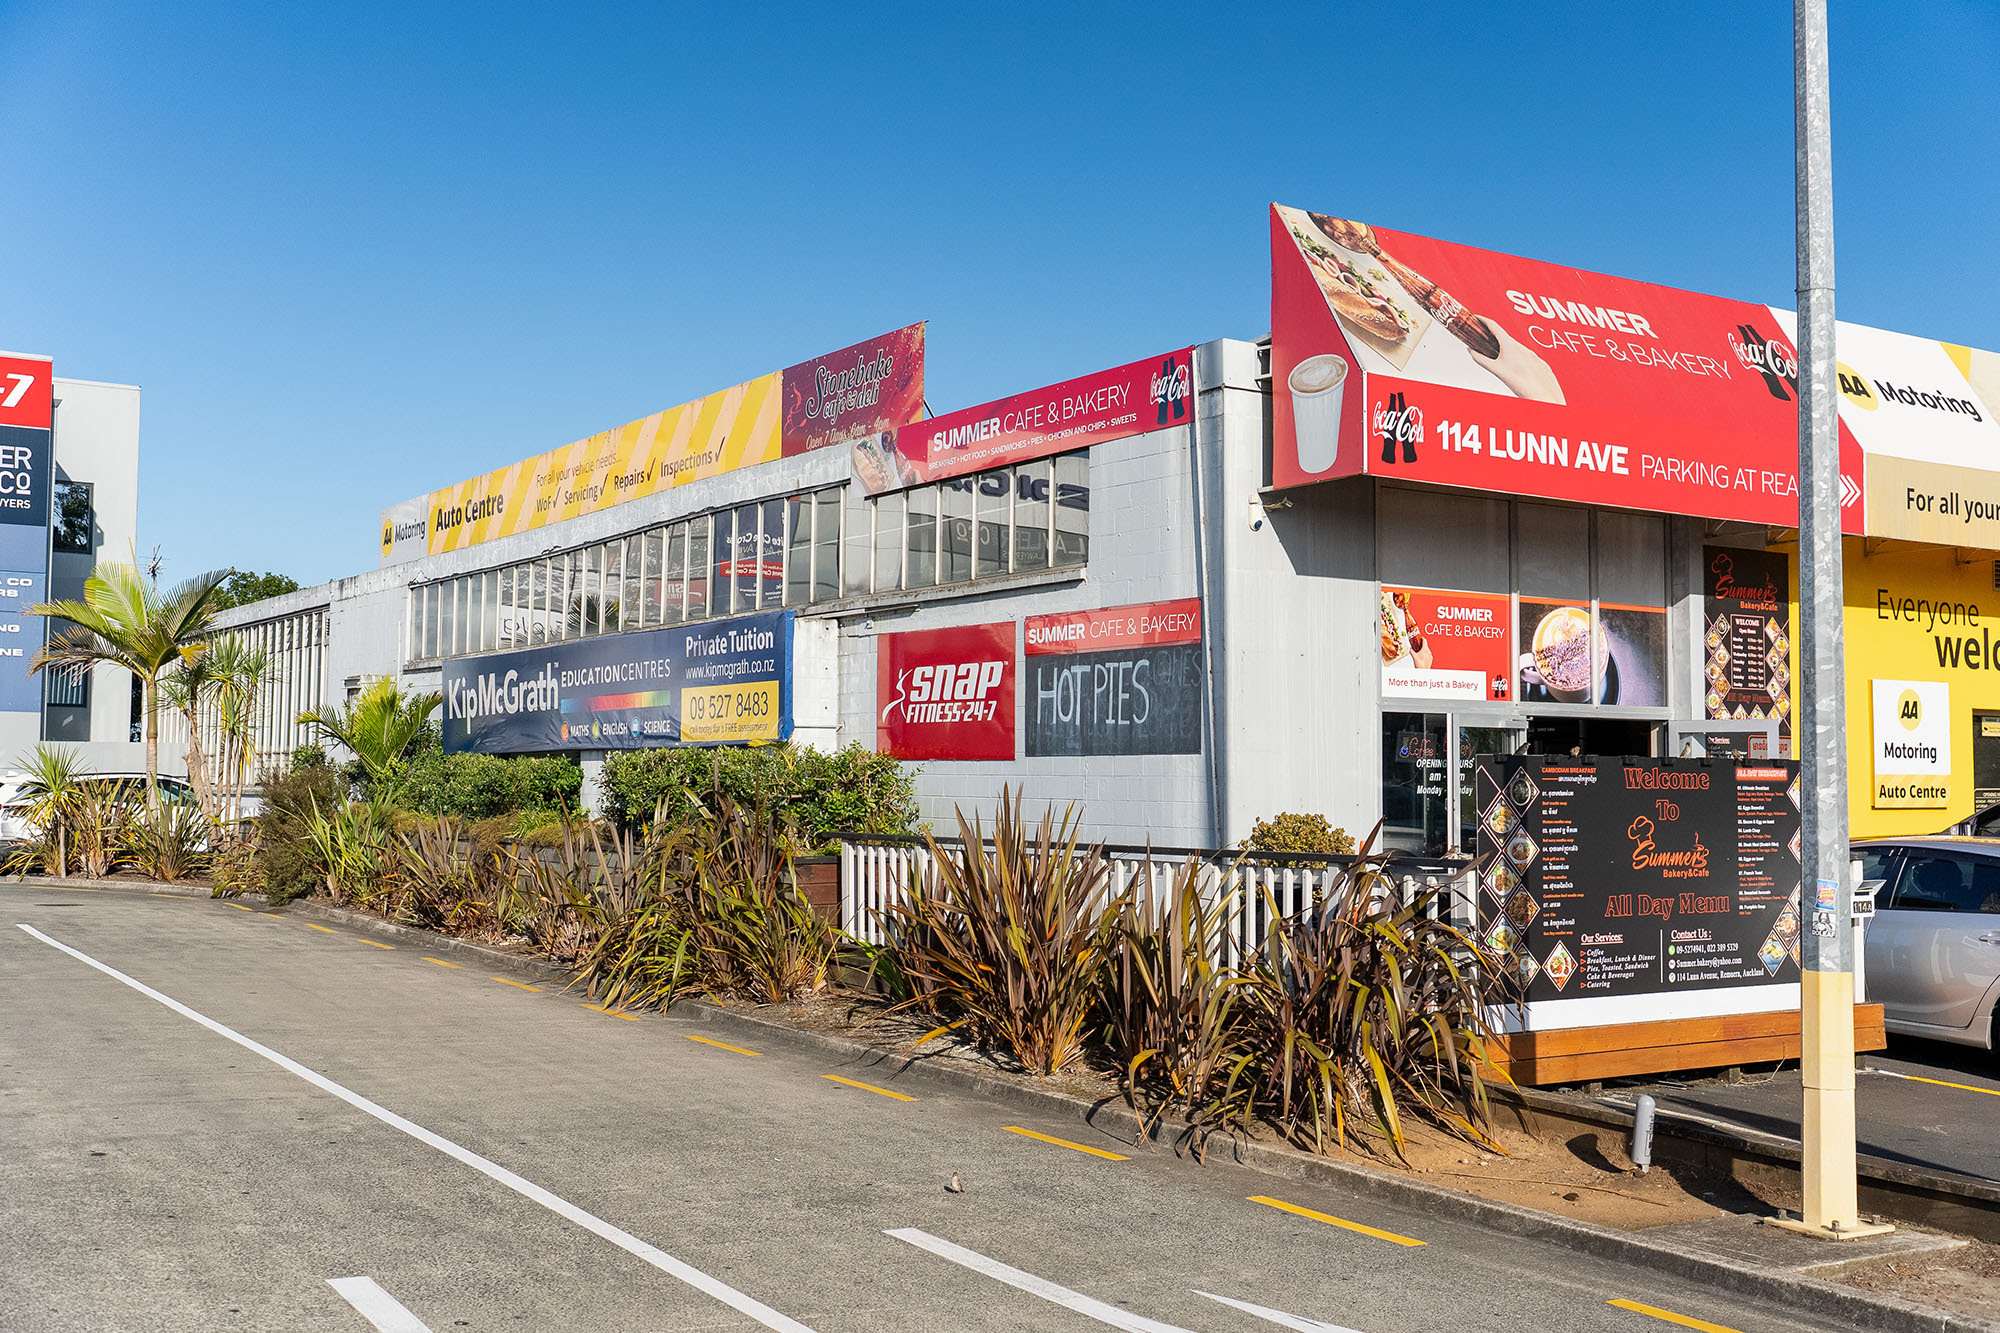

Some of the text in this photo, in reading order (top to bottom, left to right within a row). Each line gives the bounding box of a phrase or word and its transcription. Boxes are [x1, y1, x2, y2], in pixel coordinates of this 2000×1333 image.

[1506, 289, 1659, 340] SUMMER
[1528, 325, 1733, 380] CAFE & BAKERY
[1727, 332, 1798, 380] Coca-Co
[805, 349, 894, 419] Stonebake
[857, 380, 881, 409] deli
[1838, 373, 1983, 423] AA Motoring
[933, 381, 1131, 452] SUMMER CAFE & BAKERY
[928, 414, 1137, 471] BREAKFAST HOT FOOD SANDWICHES PIES CHICKEN AND CHIPS SWEETS
[1436, 420, 1799, 497] 114 LUNN AVE PARKING AT REA
[536, 474, 548, 488] For
[555, 469, 571, 486] your
[571, 460, 594, 477] vehicle
[536, 450, 713, 513] WoF Servicing Repairs Inspections
[0, 498, 32, 509] YERS
[1907, 487, 1934, 513] For
[1939, 491, 1959, 516] all
[394, 518, 426, 542] Motoring
[436, 507, 462, 532] Auto
[464, 494, 504, 523] Centre
[1437, 605, 1494, 622] SUMMER
[1877, 589, 1980, 633] Everyone
[1028, 612, 1197, 645] SUMMER CAFE & BAKERY
[1424, 622, 1453, 636] CAFE
[1454, 624, 1463, 637] &
[1463, 625, 1506, 639] BAKERY
[1735, 618, 1760, 627] WELCOME
[685, 627, 774, 658] Private Tuition
[685, 658, 775, 681] www.kipmcgrath.co.nz
[1037, 665, 1091, 725] HOT
[1094, 658, 1150, 725] PIES
[1388, 678, 1409, 686] More
[1410, 678, 1429, 687] than
[1429, 679, 1444, 689] just
[1452, 680, 1479, 692] Bakery
[690, 691, 769, 720] 09 527 8483
[1900, 700, 1919, 720] AA
[570, 720, 671, 737] MATHS ENGLISH SCIENCE
[725, 722, 738, 733] FREE
[1884, 742, 1938, 764] Motoring
[1623, 768, 1710, 790] Welcome
[1416, 785, 1443, 796] Monday
[1879, 784, 1948, 799] Auto Centre
[1656, 799, 1680, 821] To
[1604, 894, 1633, 918] All
[1638, 894, 1675, 921] Day
[1679, 892, 1731, 915] Menu
[1581, 933, 1595, 943] Our
[1595, 932, 1624, 943] Services:
[1671, 928, 1708, 940] Contact Us
[1586, 948, 1604, 957] Coffee
[1587, 956, 1614, 965] Breakfast,
[1586, 972, 1601, 980] Cake
[1607, 971, 1635, 979] Beverages
[1624, 962, 1649, 970] Sandwich
[1676, 973, 1686, 982] 114
[1742, 967, 1765, 977] Auckland
[1586, 981, 1611, 989] Catering
